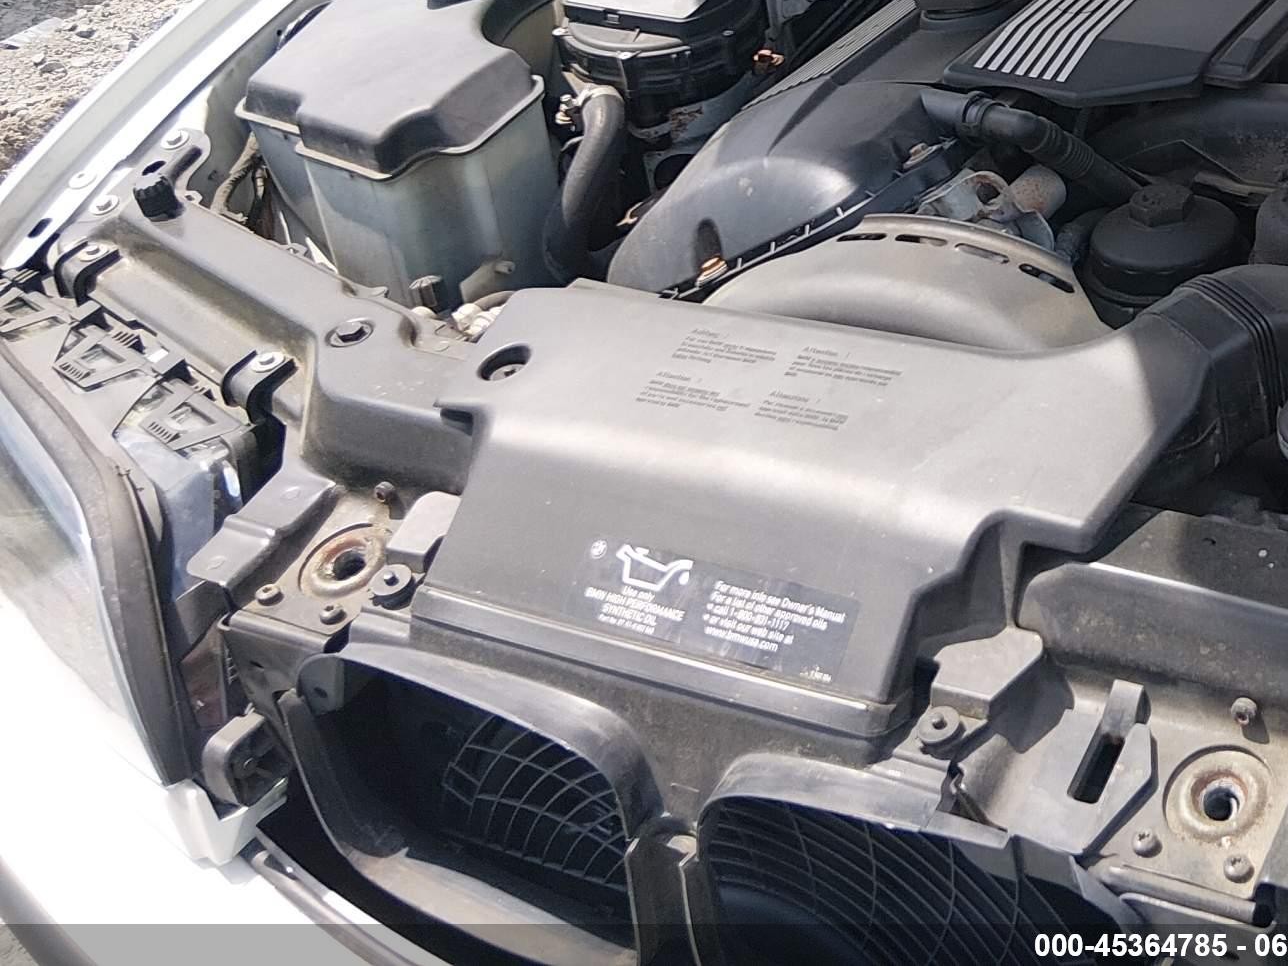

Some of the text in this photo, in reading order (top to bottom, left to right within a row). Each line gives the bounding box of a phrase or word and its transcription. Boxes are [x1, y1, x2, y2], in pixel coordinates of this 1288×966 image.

[584, 586, 686, 622] BMW HIGH PERFORMANCE
[621, 585, 655, 603] Use only
[714, 580, 847, 624] For more info see Owner's Manual
[601, 602, 646, 622] SYNTHETIC
[710, 591, 726, 604] For
[731, 597, 746, 609] list
[753, 603, 776, 617] other
[773, 609, 814, 627] approved
[811, 618, 828, 631] oils
[712, 604, 730, 616] call
[704, 626, 779, 653] www.bmwusa.com
[708, 615, 721, 625] or
[719, 616, 738, 629] visit
[735, 622, 753, 632] our
[749, 626, 769, 638] web
[767, 630, 785, 643] site
